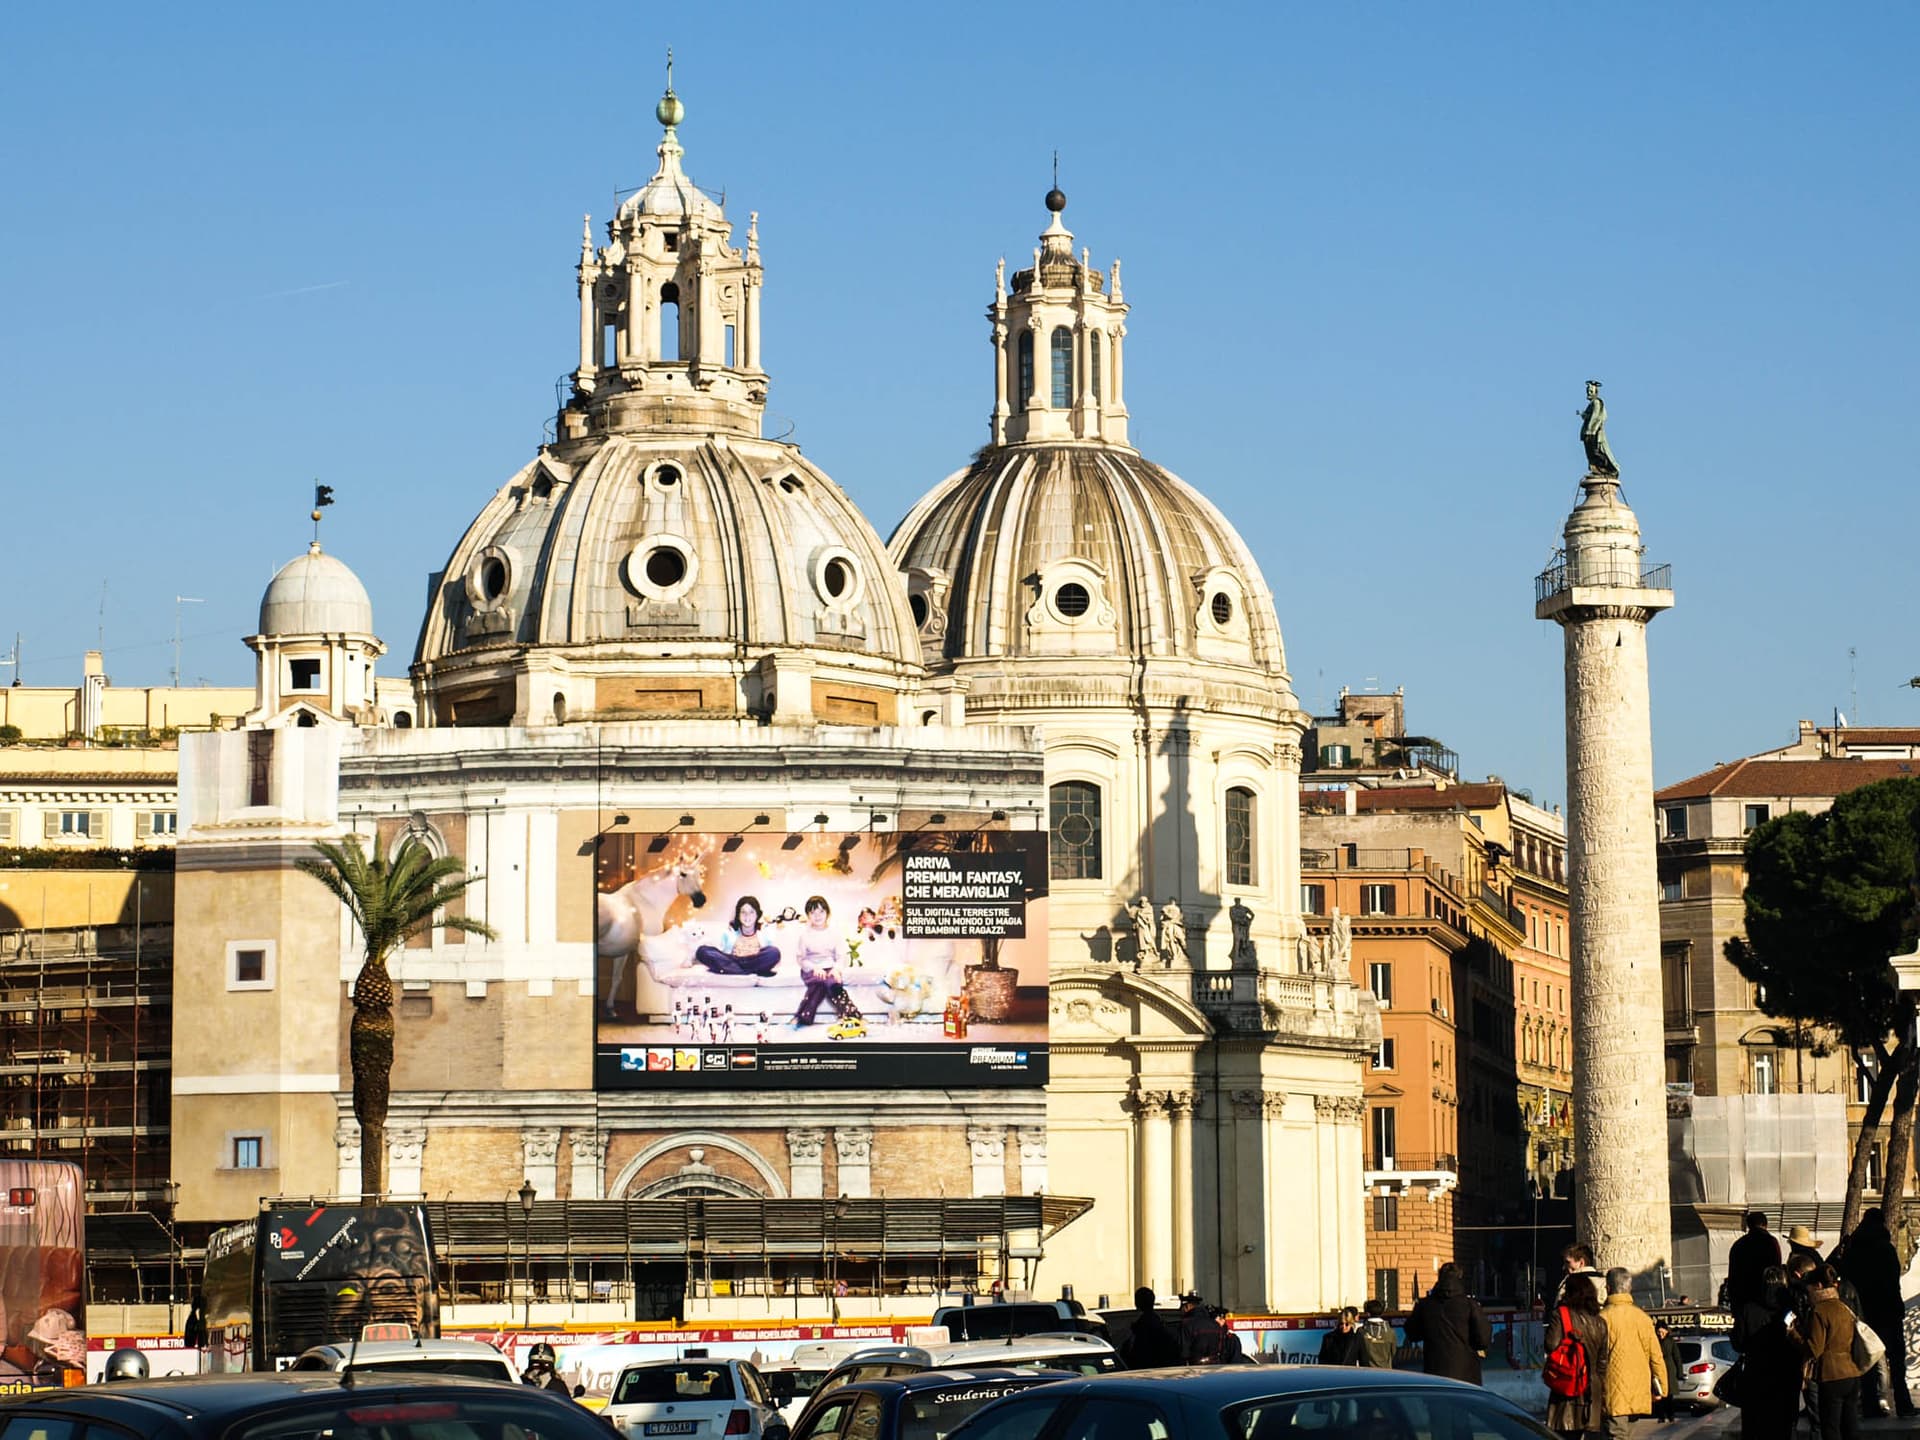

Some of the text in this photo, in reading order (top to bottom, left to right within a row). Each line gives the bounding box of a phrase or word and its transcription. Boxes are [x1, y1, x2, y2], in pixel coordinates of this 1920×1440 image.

[906, 857, 951, 869] ARRIVA
[905, 871, 1023, 885] PREMIUM FANTASY,
[905, 886, 1010, 898] CHE MERAVIGLIA!
[906, 908, 1010, 916] SUL DIGITALE TERRESTRE
[906, 917, 1023, 925] ARRIVA UN MONDO DI MAGIA
[906, 926, 923, 934] PER
[925, 926, 960, 934] BAMBINI
[961, 926, 968, 934] E
[367, 1326, 408, 1340] TAXI
[136, 1338, 158, 1349] ROMA
[934, 1389, 1000, 1404] Scuderia
